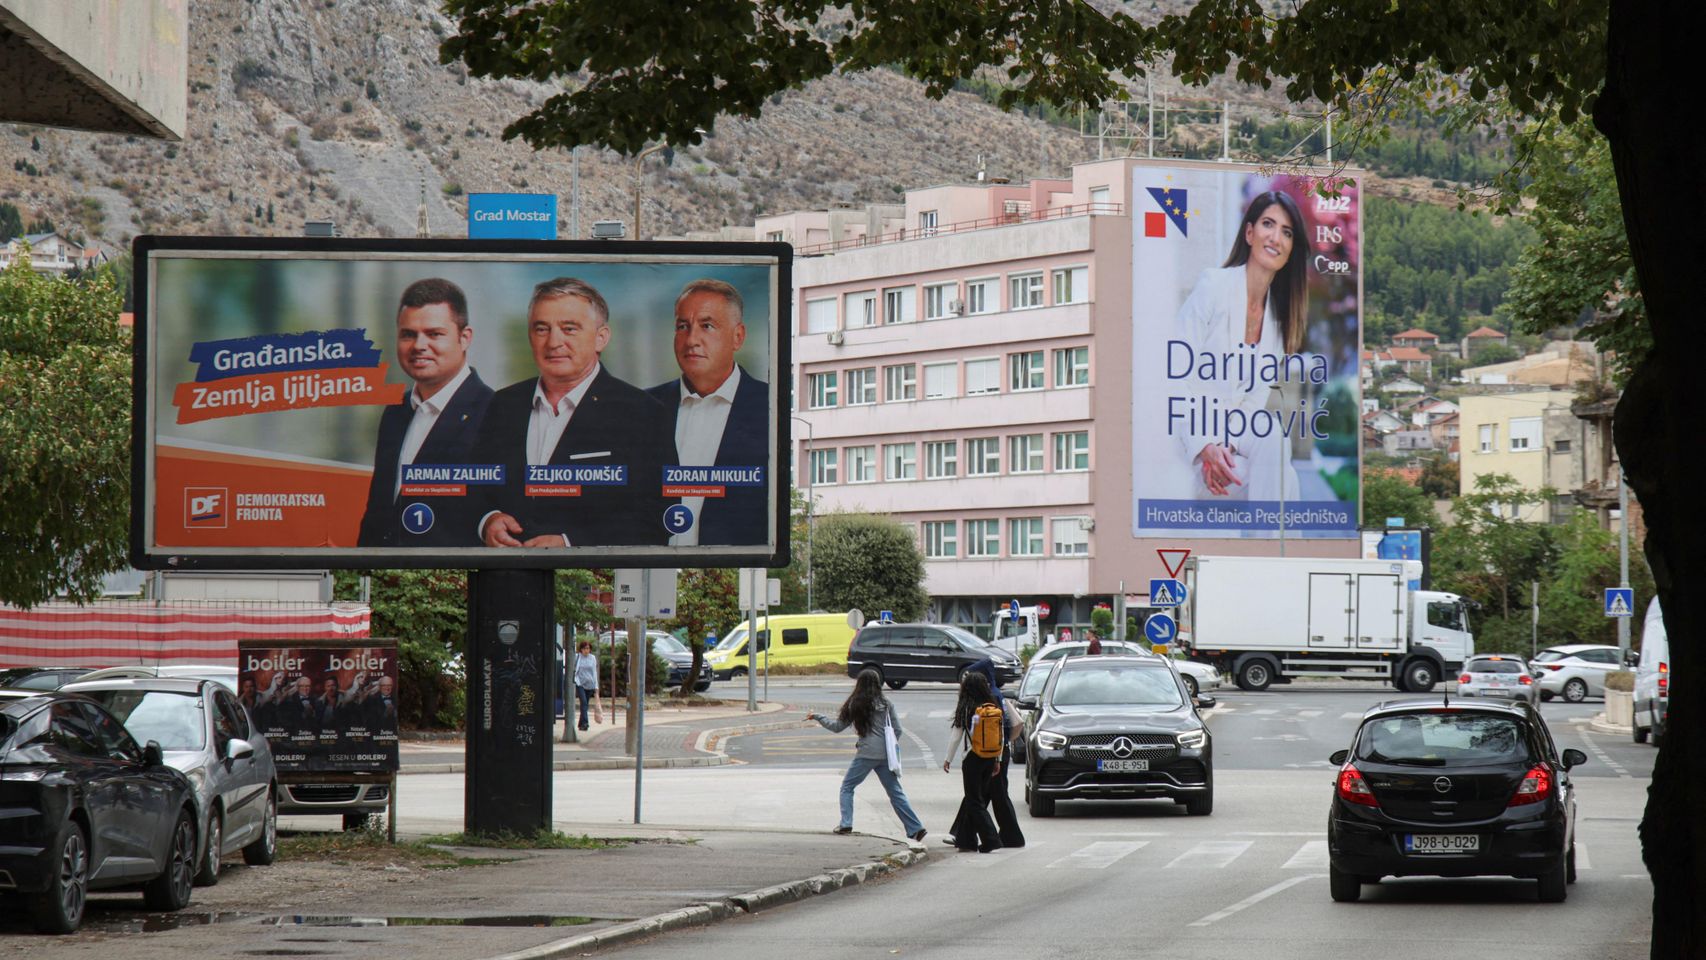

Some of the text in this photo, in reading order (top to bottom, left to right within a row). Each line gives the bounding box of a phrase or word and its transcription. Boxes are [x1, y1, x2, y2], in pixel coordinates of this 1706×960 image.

[1316, 195, 1351, 211] HDZ
[474, 209, 551, 221] Grad Mostar
[1328, 261, 1349, 272] epp
[213, 338, 353, 371] Građanska.
[1167, 340, 1328, 392] Darijana
[192, 373, 373, 410] Zemlja ljiljana.
[1168, 396, 1329, 448] Filipović
[405, 465, 501, 481] ARMAN ZALIHIĆ
[529, 466, 623, 483] ŽELJKO KOMŠIĆ
[667, 467, 760, 482] ZORAN MIKULIĆ
[191, 494, 221, 516] DF
[236, 493, 326, 507] DEMOKRATSKA
[236, 507, 283, 521] FRONTA
[413, 510, 423, 526] 1
[673, 511, 685, 527] 5
[1146, 507, 1348, 527] Hrvatska članica Predsjedništva
[247, 655, 305, 671] boiler
[330, 654, 387, 671] boiler
[483, 658, 492, 730] EUROPLAKAT
[1103, 760, 1147, 770] K48-E-951
